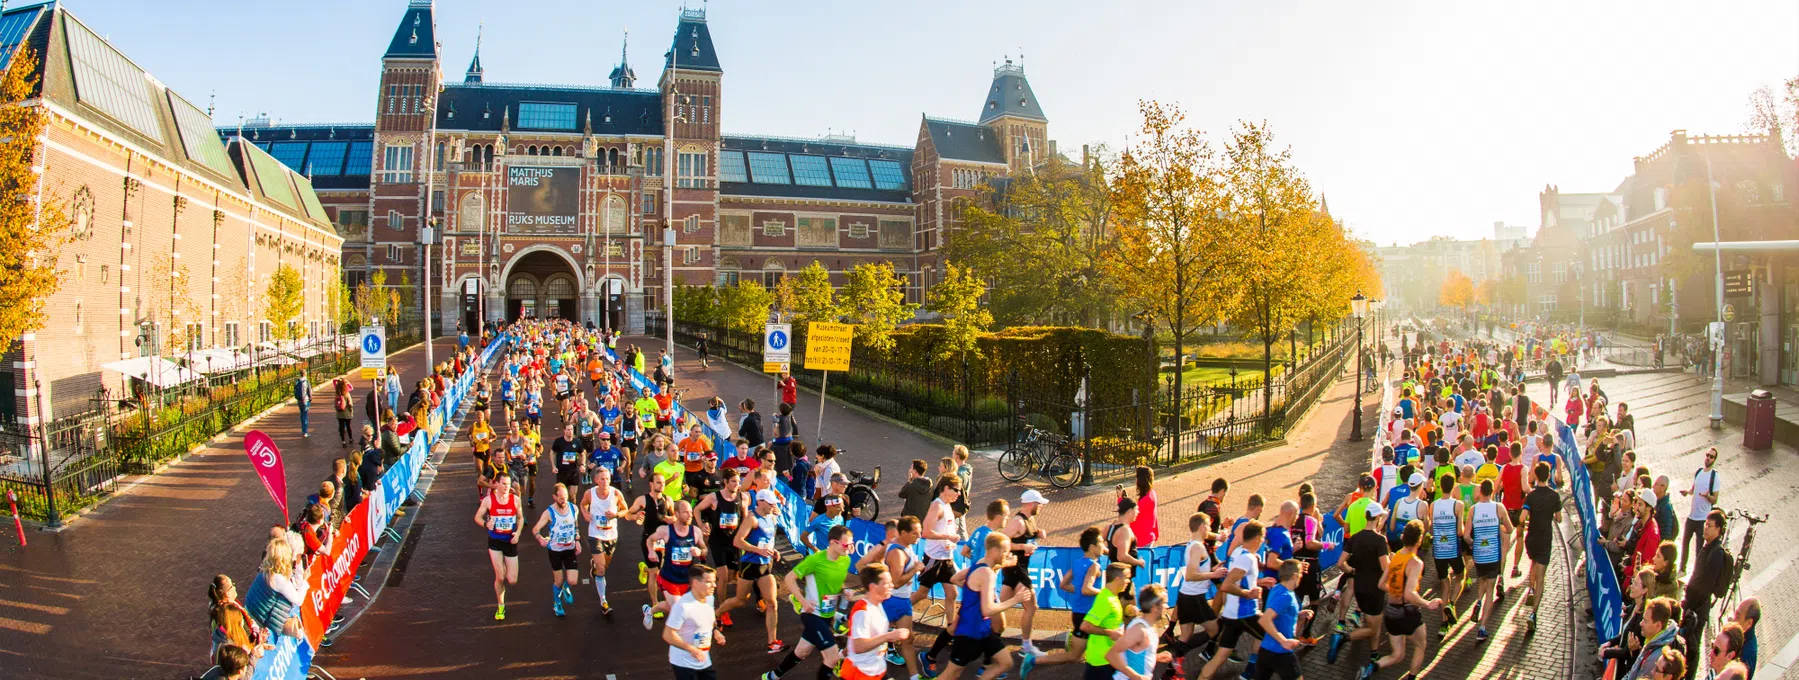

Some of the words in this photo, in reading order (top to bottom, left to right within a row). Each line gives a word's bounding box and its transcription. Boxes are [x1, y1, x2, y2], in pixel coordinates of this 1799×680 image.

[510, 168, 554, 178] MATTHIJS
[510, 177, 539, 187] MARIS
[508, 215, 534, 225] RIJKS
[535, 216, 575, 225] MUSEUM
